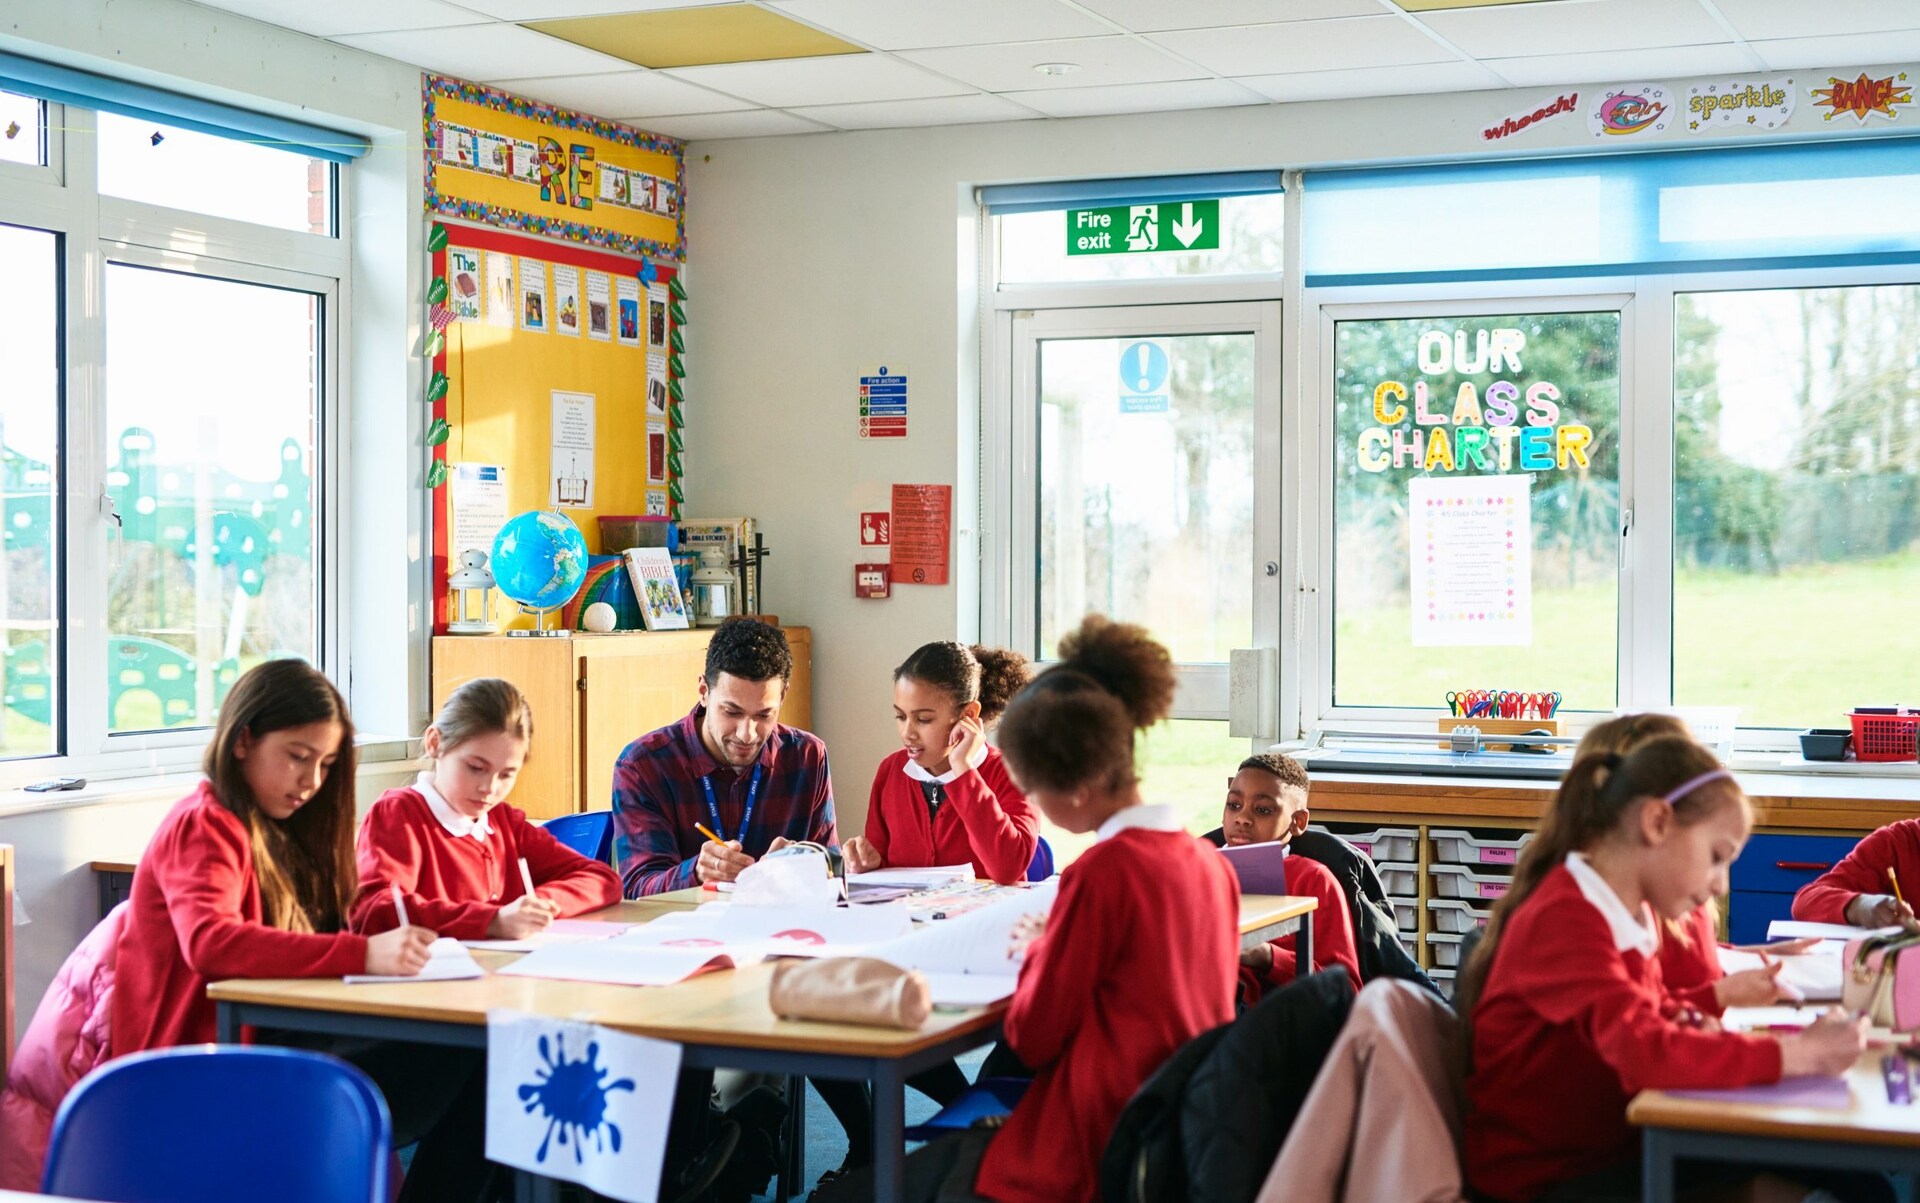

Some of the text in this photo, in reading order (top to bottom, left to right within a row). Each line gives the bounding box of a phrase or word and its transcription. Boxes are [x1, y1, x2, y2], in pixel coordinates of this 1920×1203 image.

[1690, 84, 1786, 121] sparkle
[1832, 76, 1893, 109] BANG!
[1484, 93, 1578, 140] whoosh!
[473, 130, 507, 143] Judaism
[513, 139, 535, 150] Islam
[538, 136, 594, 211] RE
[1077, 211, 1112, 229] Fire
[1077, 232, 1111, 250] exit
[453, 253, 476, 272] The
[454, 300, 478, 318] Bible
[1418, 328, 1526, 375] OUR
[1373, 380, 1561, 427] CLASS
[1357, 424, 1592, 472] CHARTER
[640, 565, 672, 578] BIBLE
